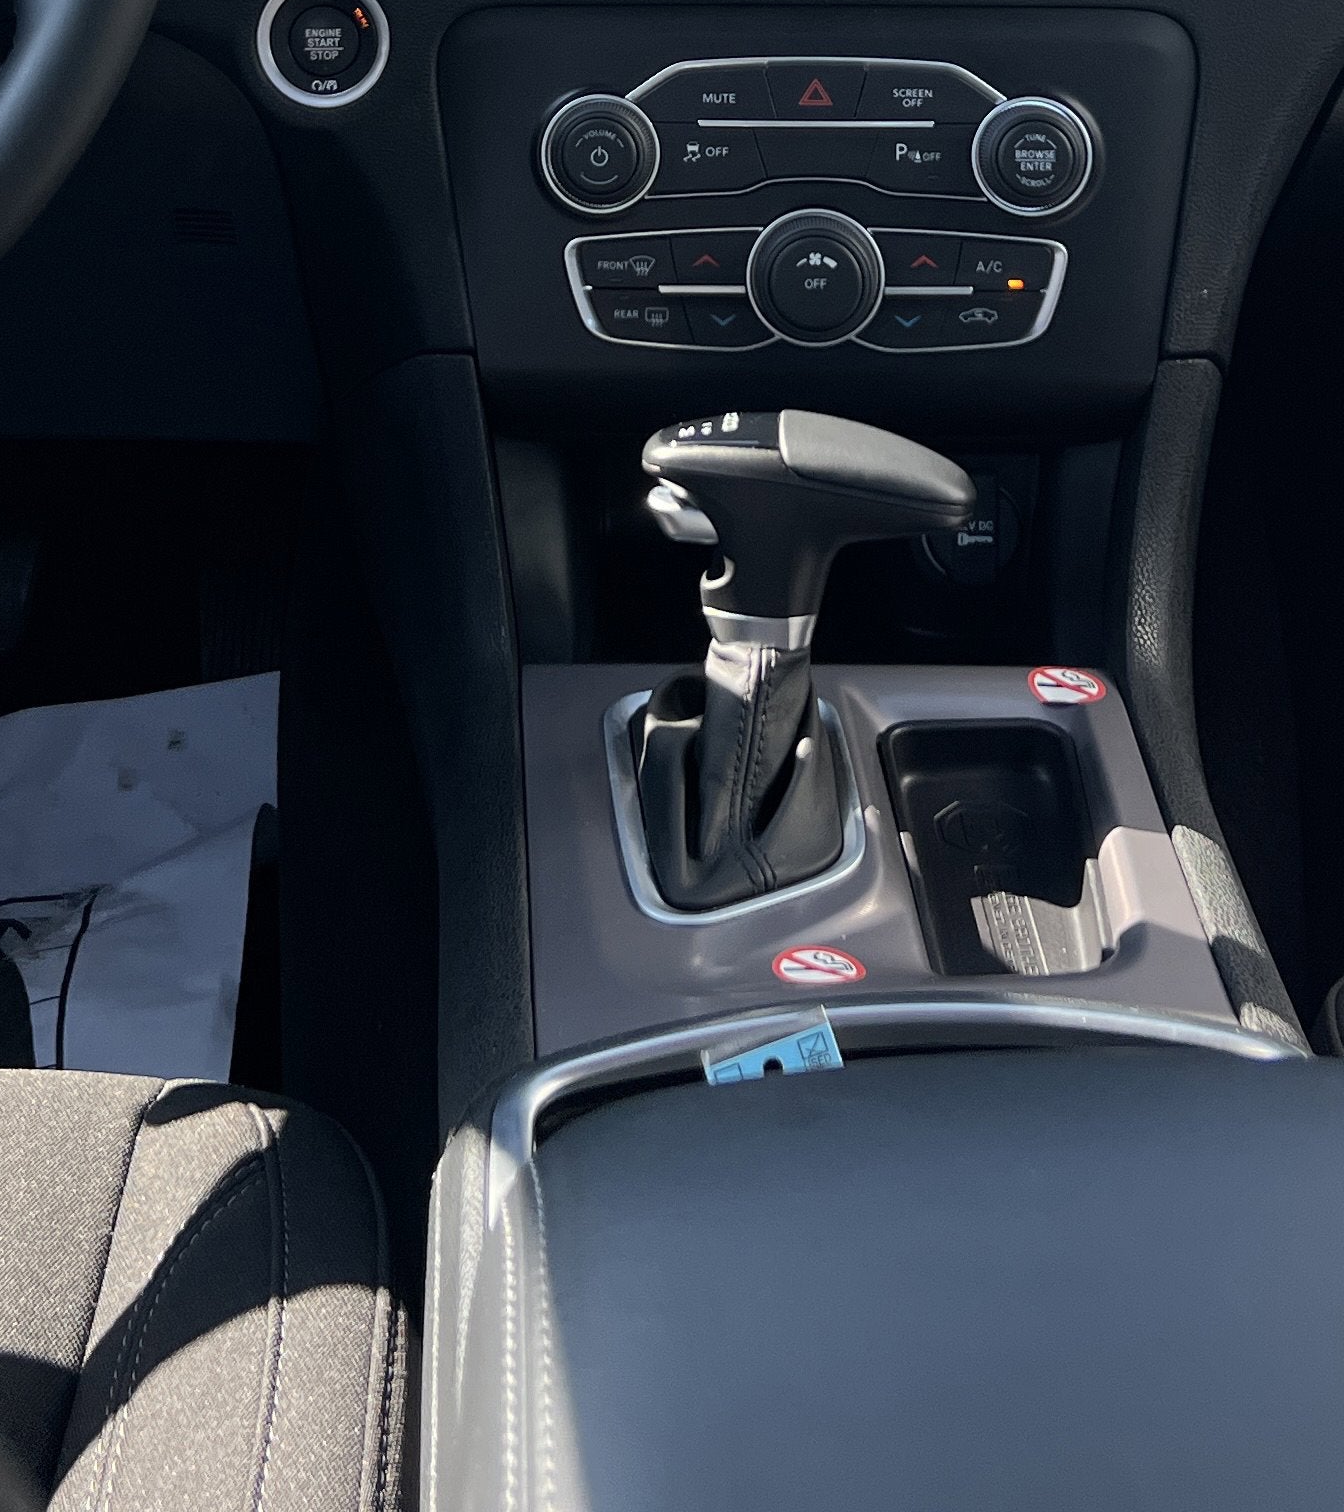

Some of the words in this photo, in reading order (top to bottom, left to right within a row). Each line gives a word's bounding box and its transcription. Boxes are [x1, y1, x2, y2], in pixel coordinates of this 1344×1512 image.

[305, 28, 342, 38] ENGINE
[307, 38, 341, 48] START
[309, 50, 339, 61] STOP
[702, 93, 737, 104] MUTE
[892, 88, 933, 99] SCREEN
[902, 98, 924, 108] OFF
[582, 129, 618, 141] VOLUME
[1024, 133, 1047, 143] TUNE
[705, 145, 729, 158] OFF
[922, 152, 941, 162] OFF
[1015, 149, 1055, 160] BROWSE
[1020, 161, 1053, 172] ENTER
[1018, 173, 1052, 187] SCROLL
[597, 260, 629, 270] FRONT
[976, 260, 1003, 273] A/C
[804, 278, 827, 289] OFF
[614, 308, 639, 319] REAR
